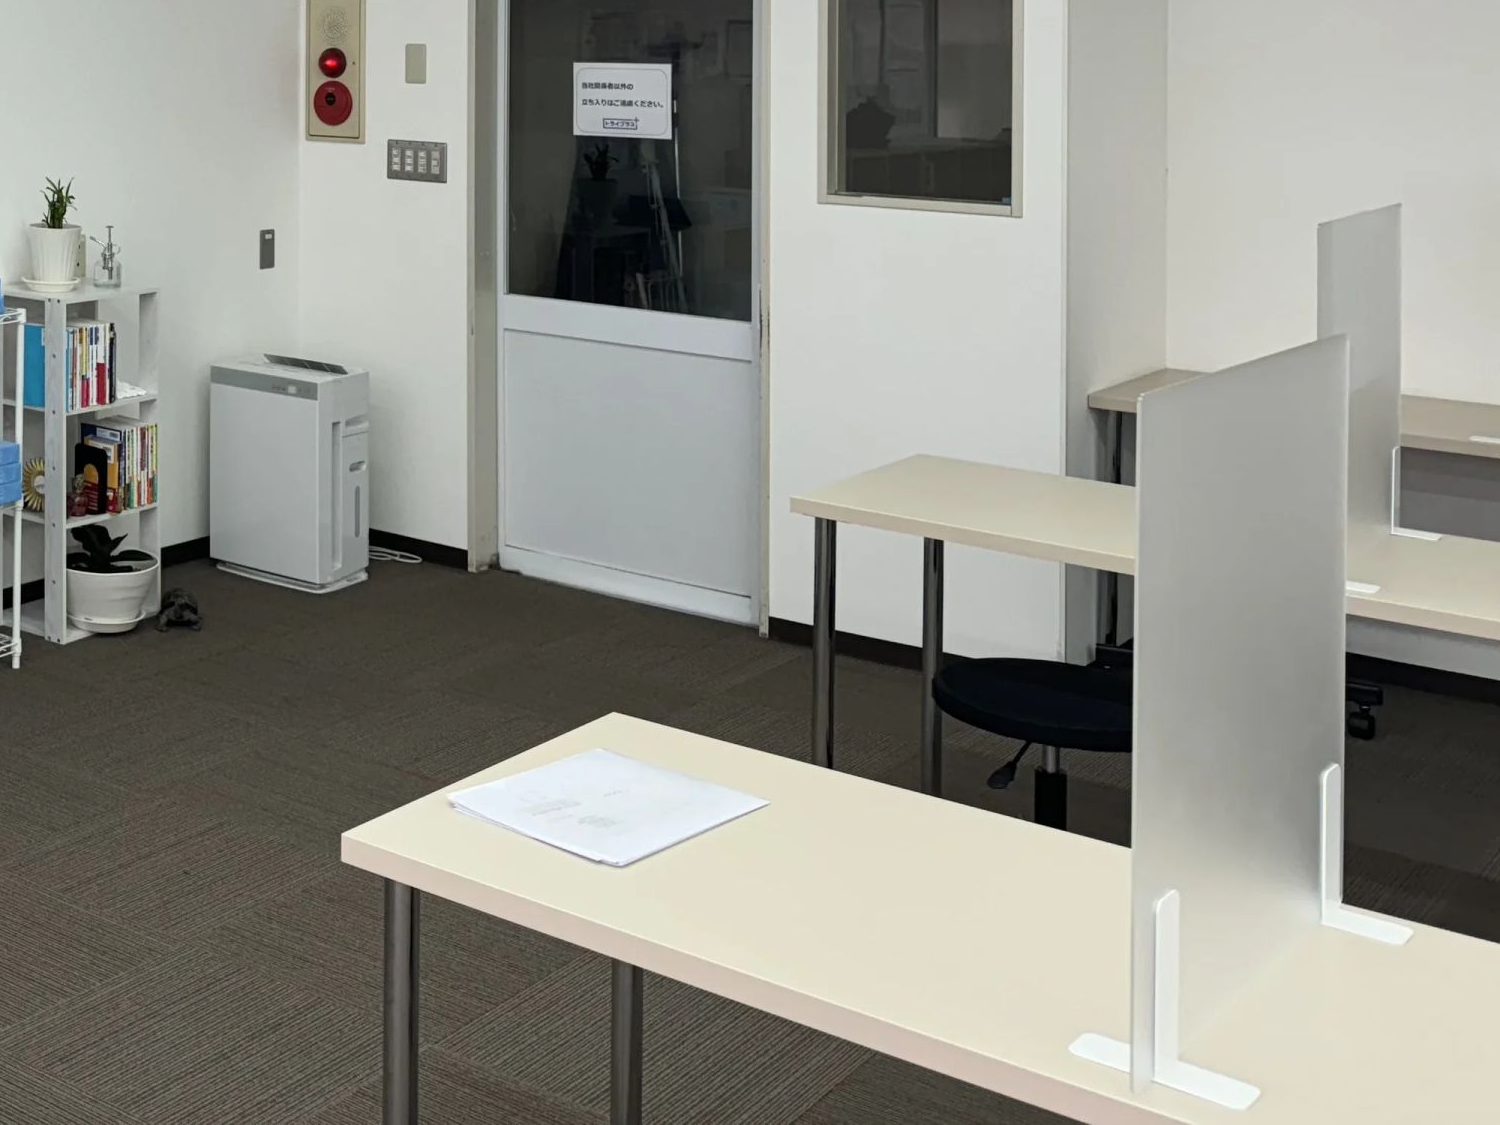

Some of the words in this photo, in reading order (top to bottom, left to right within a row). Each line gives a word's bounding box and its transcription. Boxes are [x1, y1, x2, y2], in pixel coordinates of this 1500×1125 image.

[581, 82, 633, 90] 当社関係者以外の
[581, 99, 663, 108] 立ち入りはご遠慮ください。
